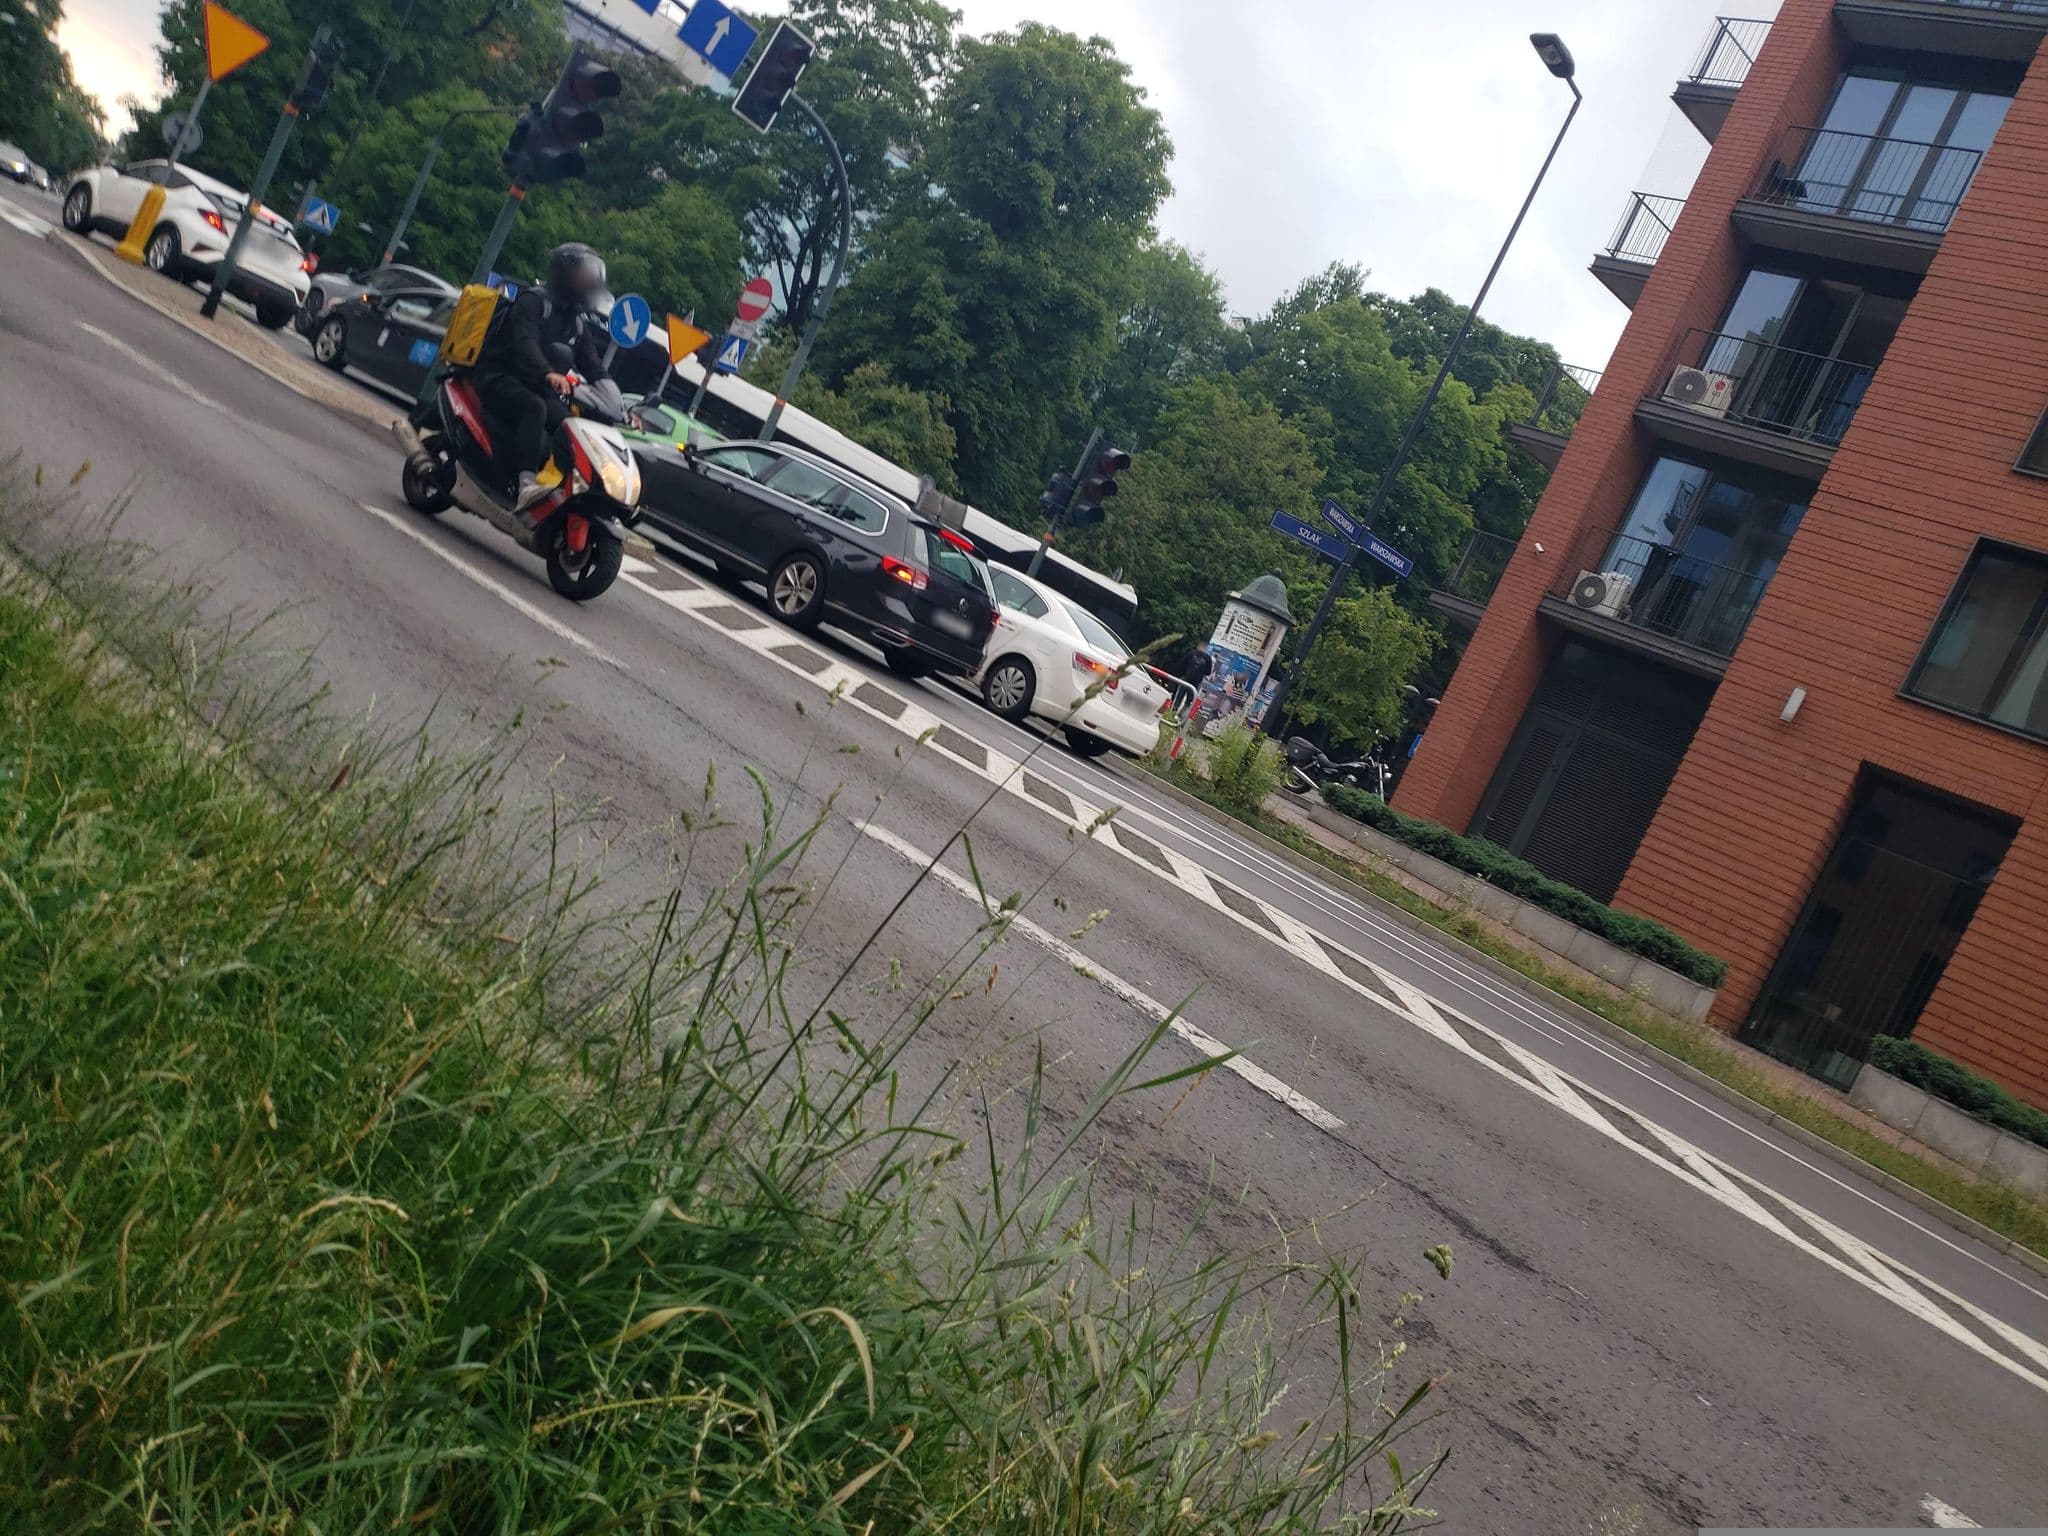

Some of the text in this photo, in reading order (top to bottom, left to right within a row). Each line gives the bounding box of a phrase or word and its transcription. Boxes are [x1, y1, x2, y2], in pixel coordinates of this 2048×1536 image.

[1329, 507, 1355, 535] WARSZAWSKA
[1297, 527, 1322, 545] SZLAK
[1370, 541, 1405, 570] WARSZAWSKA
